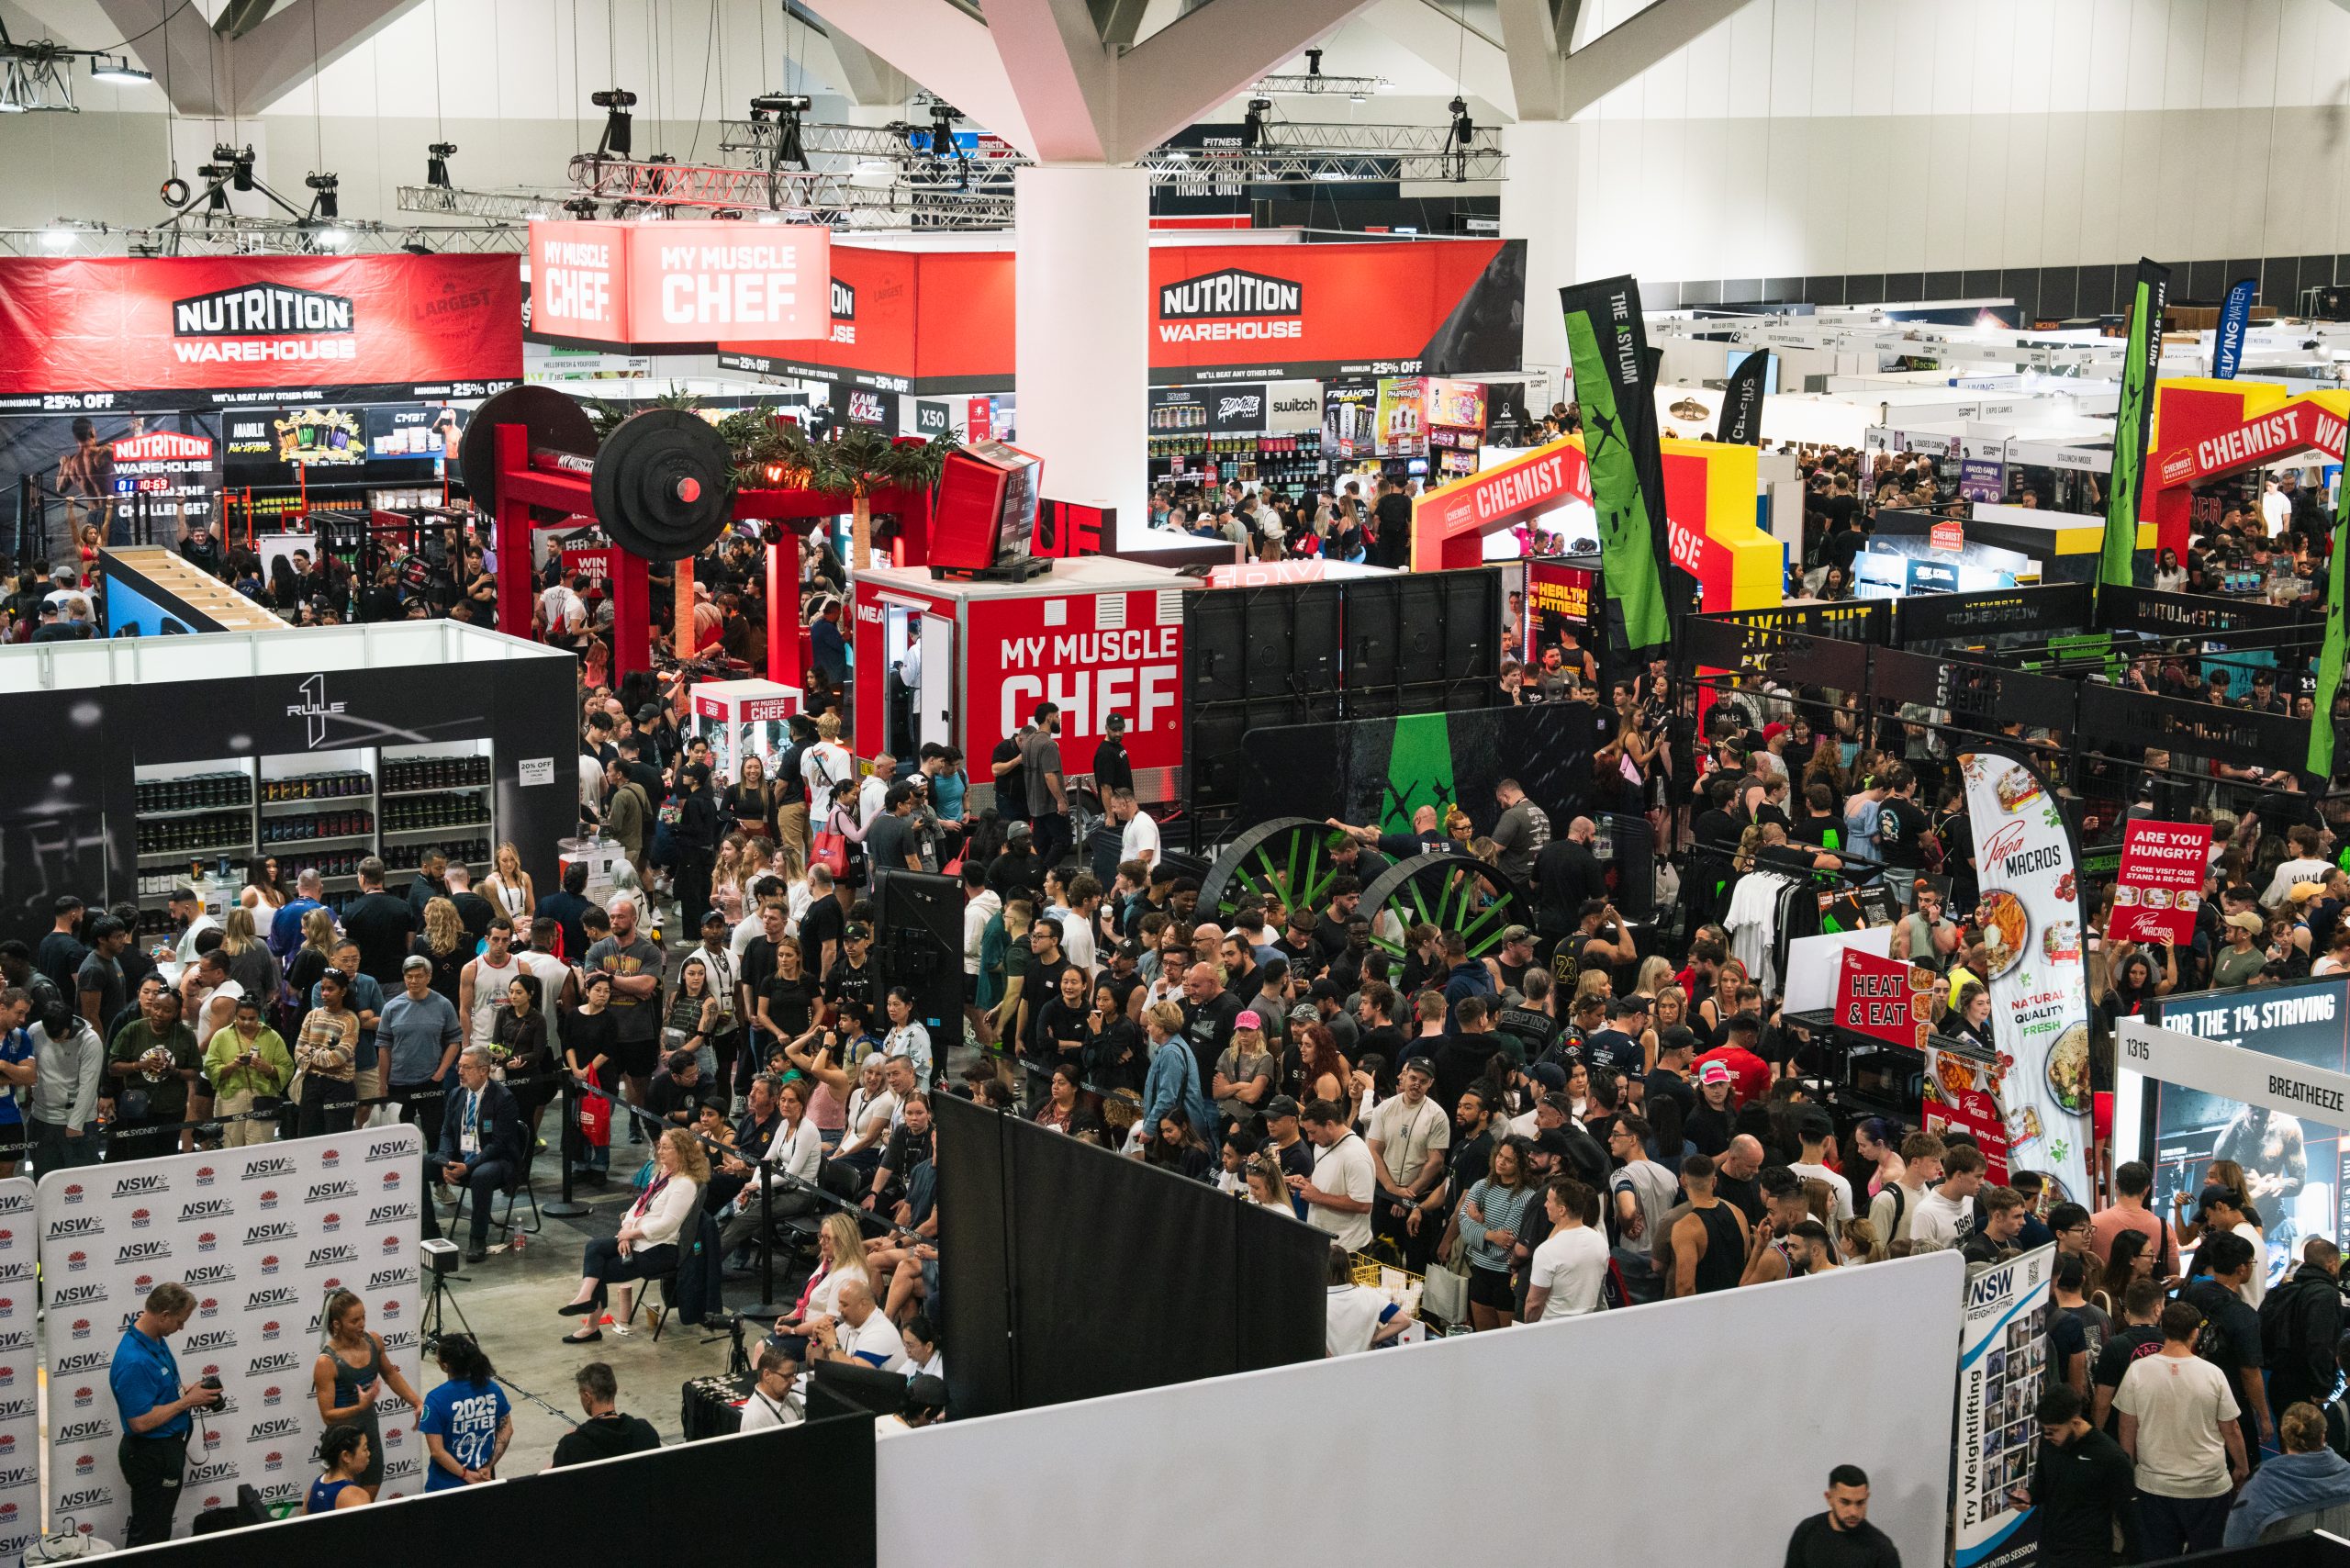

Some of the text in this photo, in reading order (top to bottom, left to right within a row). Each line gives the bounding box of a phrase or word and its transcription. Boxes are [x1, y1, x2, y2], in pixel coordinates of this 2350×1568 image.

[544, 241, 609, 268] MY MUSCLE
[661, 245, 796, 270] MY MUSCLE
[1164, 274, 1299, 314] NUTRITION
[177, 286, 349, 332] NUTRITION
[1159, 321, 1302, 342] WAREHOUSE
[2149, 281, 2166, 368] THE ASYLUM
[1610, 291, 1639, 385] THE ASYLUM
[173, 338, 356, 363] WAREHOUSE
[756, 359, 770, 372] OFF
[1197, 371, 1215, 379] WE'LL
[1216, 370, 1231, 378] BEAT
[1247, 369, 1267, 377] OTHER
[1371, 363, 1399, 375] 25%
[1401, 361, 1422, 374] OFF
[414, 382, 485, 396] MINIMUM 25%
[893, 378, 909, 392] OFF
[0, 394, 114, 409] MINIMUM 25% OFF
[237, 393, 257, 401] BEAT
[258, 392, 275, 401] ANY
[276, 392, 302, 400] OTHER
[303, 391, 323, 399] DEAL
[851, 392, 878, 407] KAMI
[848, 405, 883, 421] KAZE
[1220, 396, 1260, 415] ZOMBIE
[1273, 398, 1317, 412] switch
[921, 409, 945, 428] X50
[233, 423, 264, 438] ANABOLIX
[116, 434, 208, 458] NUTRITION
[1914, 440, 1945, 449] LOADED CANDY
[2198, 410, 2299, 470] CHEMIST
[113, 461, 212, 474] WAREHOUSE
[2076, 455, 2092, 465] MODE
[2164, 458, 2192, 474] CHEMIST
[1476, 456, 1562, 519] CHEMIST
[1447, 505, 1472, 522] CHEMIST
[1932, 530, 1962, 543] CHEMIST
[578, 557, 607, 567] WIN
[578, 567, 607, 578] WIN
[1539, 582, 1587, 603] HEALTH
[1529, 595, 1587, 616] & FITNESS
[1002, 628, 1177, 669] MY MUSCLE
[287, 702, 345, 716] RULE
[1001, 665, 1177, 740] CHEF
[1983, 820, 2025, 872] Papa
[2134, 831, 2202, 846] ARE YOU
[2006, 845, 2061, 878] MACROS
[2130, 845, 2202, 861] HUNGRY?
[2126, 872, 2154, 881] STAND
[2163, 875, 2196, 884] RE-FUEL
[2130, 866, 2154, 874] COME
[2155, 867, 2177, 875] VISIT
[2131, 912, 2159, 929] Papa
[2142, 924, 2173, 937] MACROS
[1556, 955, 1578, 985] 23
[1852, 975, 1904, 998] HEAT
[2011, 989, 2065, 1010] NATURAL
[1849, 1002, 1907, 1025] & EAT
[2014, 1004, 2065, 1025] QUALITY
[2162, 994, 2335, 1037] FOR THE 1% STRIVING
[2023, 1021, 2061, 1037] FRESH
[2126, 1038, 2149, 1060] 1315
[2268, 1074, 2344, 1113] BREATHEEZE
[246, 1110, 274, 1119] SYDNEY
[130, 1126, 159, 1137] SYDNEY
[1975, 1128, 1991, 1140] Why
[10, 1141, 39, 1150] SYDNEY
[369, 1140, 408, 1156] NSW
[322, 1159, 339, 1167] NSW
[196, 1176, 214, 1185] NSW
[383, 1182, 399, 1190] NSW
[182, 1199, 223, 1215] NSW
[369, 1204, 408, 1219] NSW
[131, 1217, 151, 1227] NSW
[118, 1241, 161, 1258] NSW
[55, 1285, 96, 1302] NSW
[1970, 1267, 2014, 1306] NSW
[1967, 1297, 2013, 1322] WEIGHTLIFTING
[186, 1331, 226, 1348] NSW
[250, 1353, 288, 1370] NSW
[452, 1394, 497, 1422] 2025
[252, 1418, 289, 1436] NSW
[1964, 1370, 1981, 1529] Try Weightlifting
[189, 1462, 228, 1480] NSW
[1990, 1541, 2038, 1568] INTRO SESSION
